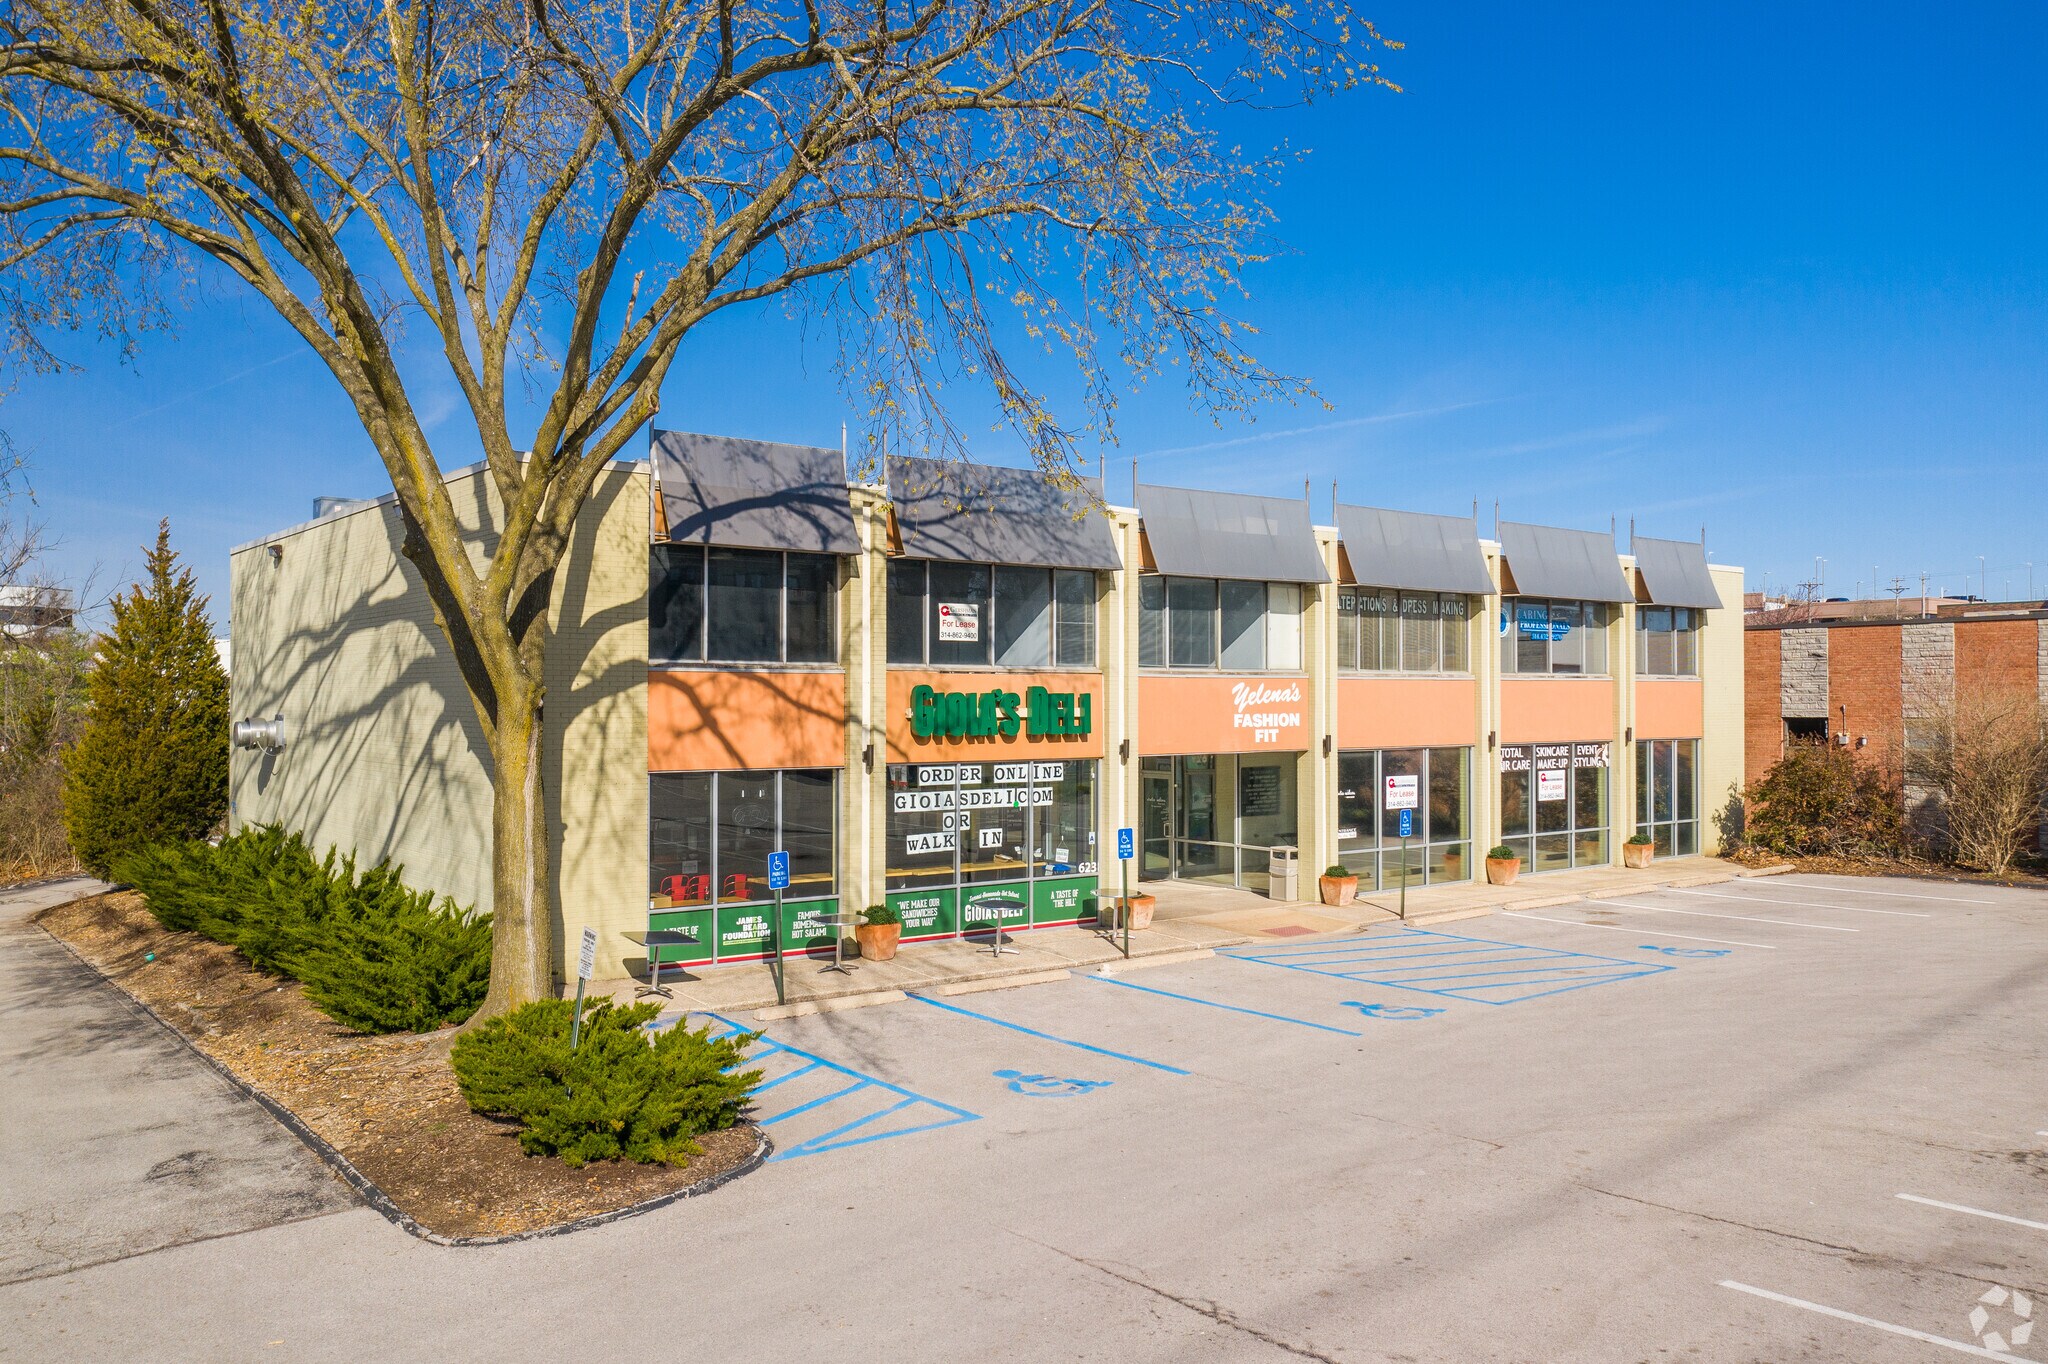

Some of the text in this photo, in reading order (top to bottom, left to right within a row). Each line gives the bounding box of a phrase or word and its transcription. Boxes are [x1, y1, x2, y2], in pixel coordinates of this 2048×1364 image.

[955, 620, 976, 628] Lease
[1232, 682, 1301, 713] Yelena's
[910, 685, 1091, 737] GIOIA'S DELI
[1233, 713, 1300, 728] FASHION
[1255, 729, 1279, 742] FIT
[1501, 748, 1523, 758] TOTAL
[1536, 746, 1569, 757] SKINCARE
[1577, 745, 1598, 755] EVENT
[1512, 760, 1530, 770] CARE
[1537, 758, 1568, 769] MAKE-UP
[920, 765, 1063, 783] ORDER ONLINE
[1390, 789, 1414, 798] For Lease
[944, 815, 969, 828] OR
[908, 831, 1002, 851] WALK IN
[1078, 862, 1097, 873] 623
[1051, 889, 1079, 899] A TASTE OF
[911, 899, 928, 908] MAKE
[929, 898, 940, 907] OUR
[902, 908, 938, 919] SANDWICHES
[965, 905, 999, 921] GIOIAS
[736, 916, 762, 925] JAMES
[905, 919, 920, 928] YOUR
[690, 926, 699, 934] OF
[742, 923, 768, 932] BEARD
[723, 930, 770, 940] FOUNDATION
[792, 928, 826, 938] HOT SALAMI
